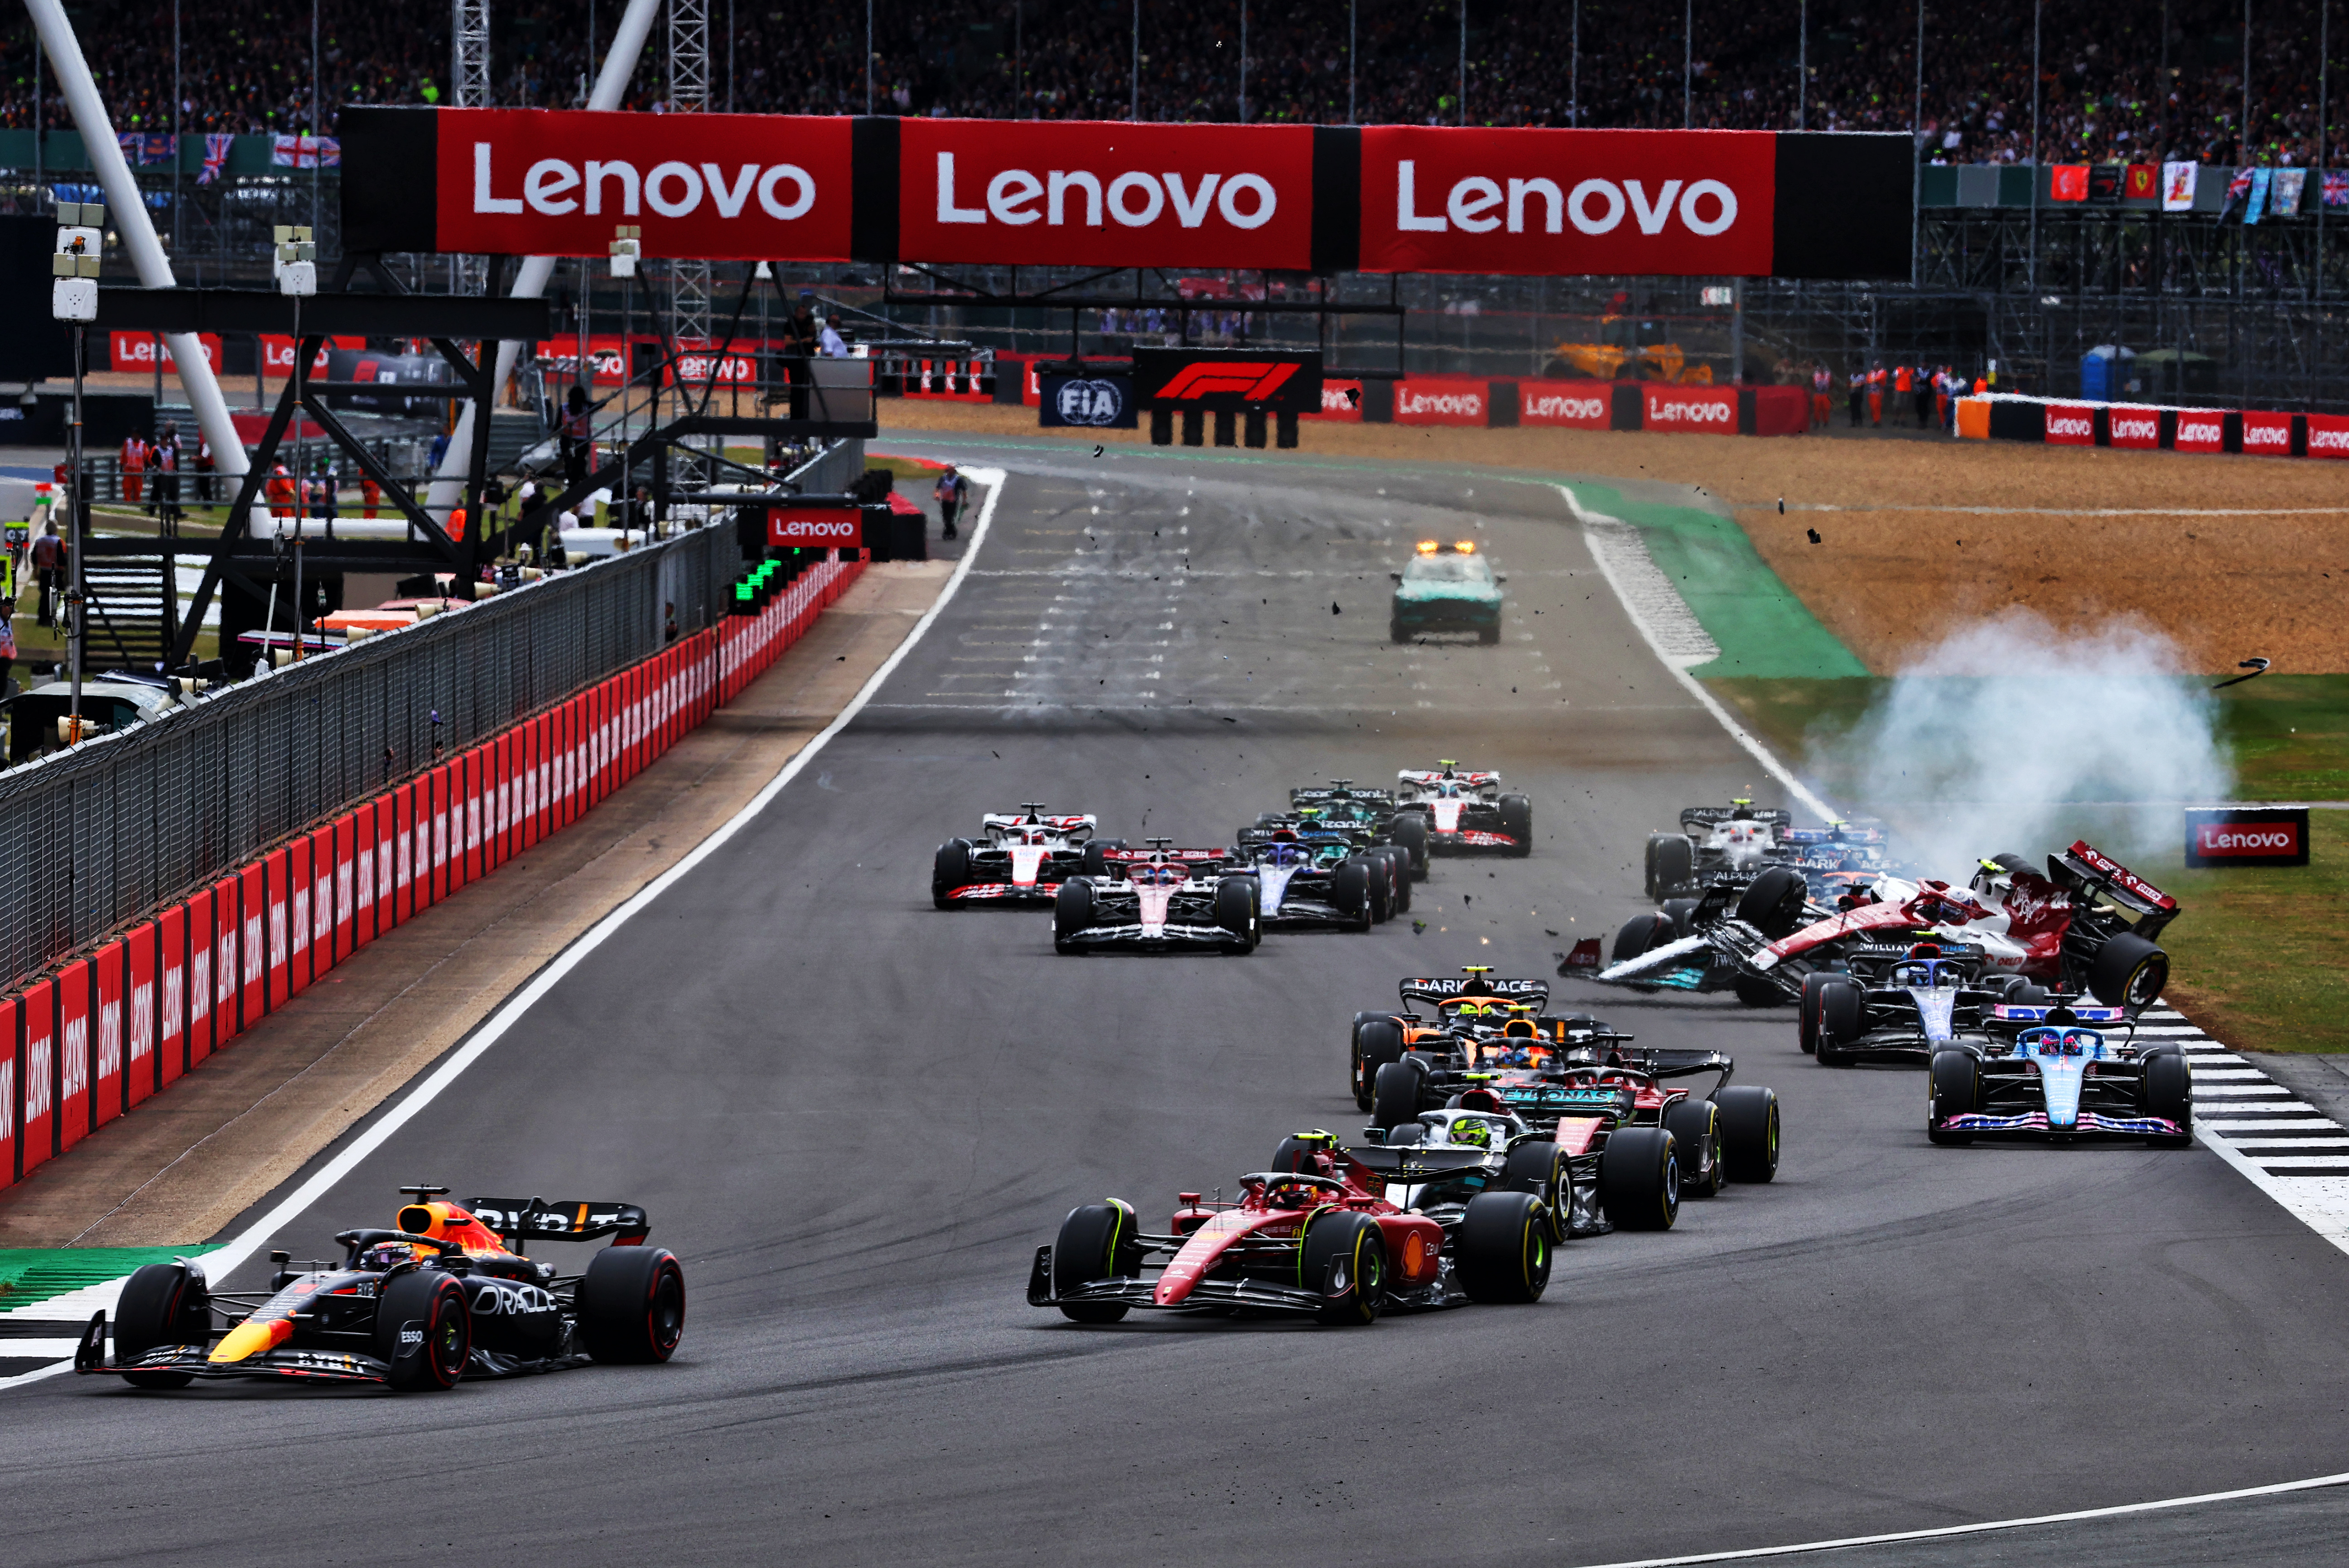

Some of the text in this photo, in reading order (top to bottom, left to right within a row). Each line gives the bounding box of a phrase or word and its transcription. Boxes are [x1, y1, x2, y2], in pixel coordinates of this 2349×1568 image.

[474, 142, 816, 220] Lenovo
[937, 151, 1277, 229] Lenovo
[1397, 159, 1738, 236] Lenovo
[120, 337, 212, 361] Leno
[1399, 387, 1481, 415] Lenovo
[1526, 393, 1604, 419] Lenovo
[1650, 397, 1731, 423] Lenovo
[2046, 412, 2092, 436] Lenovo
[2112, 416, 2156, 439] Lenovo
[2178, 419, 2221, 442] Lenovo
[2244, 422, 2289, 445] Lenovo
[2310, 425, 2349, 449] Lenov
[776, 519, 854, 536] Lenovo
[2205, 830, 2289, 849] Lenovo
[163, 953, 183, 1041] Lenovo
[1414, 979, 1533, 993] DARKACE
[131, 971, 153, 1062] Lenovo
[98, 987, 121, 1080] Lenovo
[62, 1004, 87, 1100] Lenovo
[26, 1025, 51, 1124] Lenovo
[470, 1285, 559, 1315] ORACLE
[401, 1330, 424, 1343] ESSO
